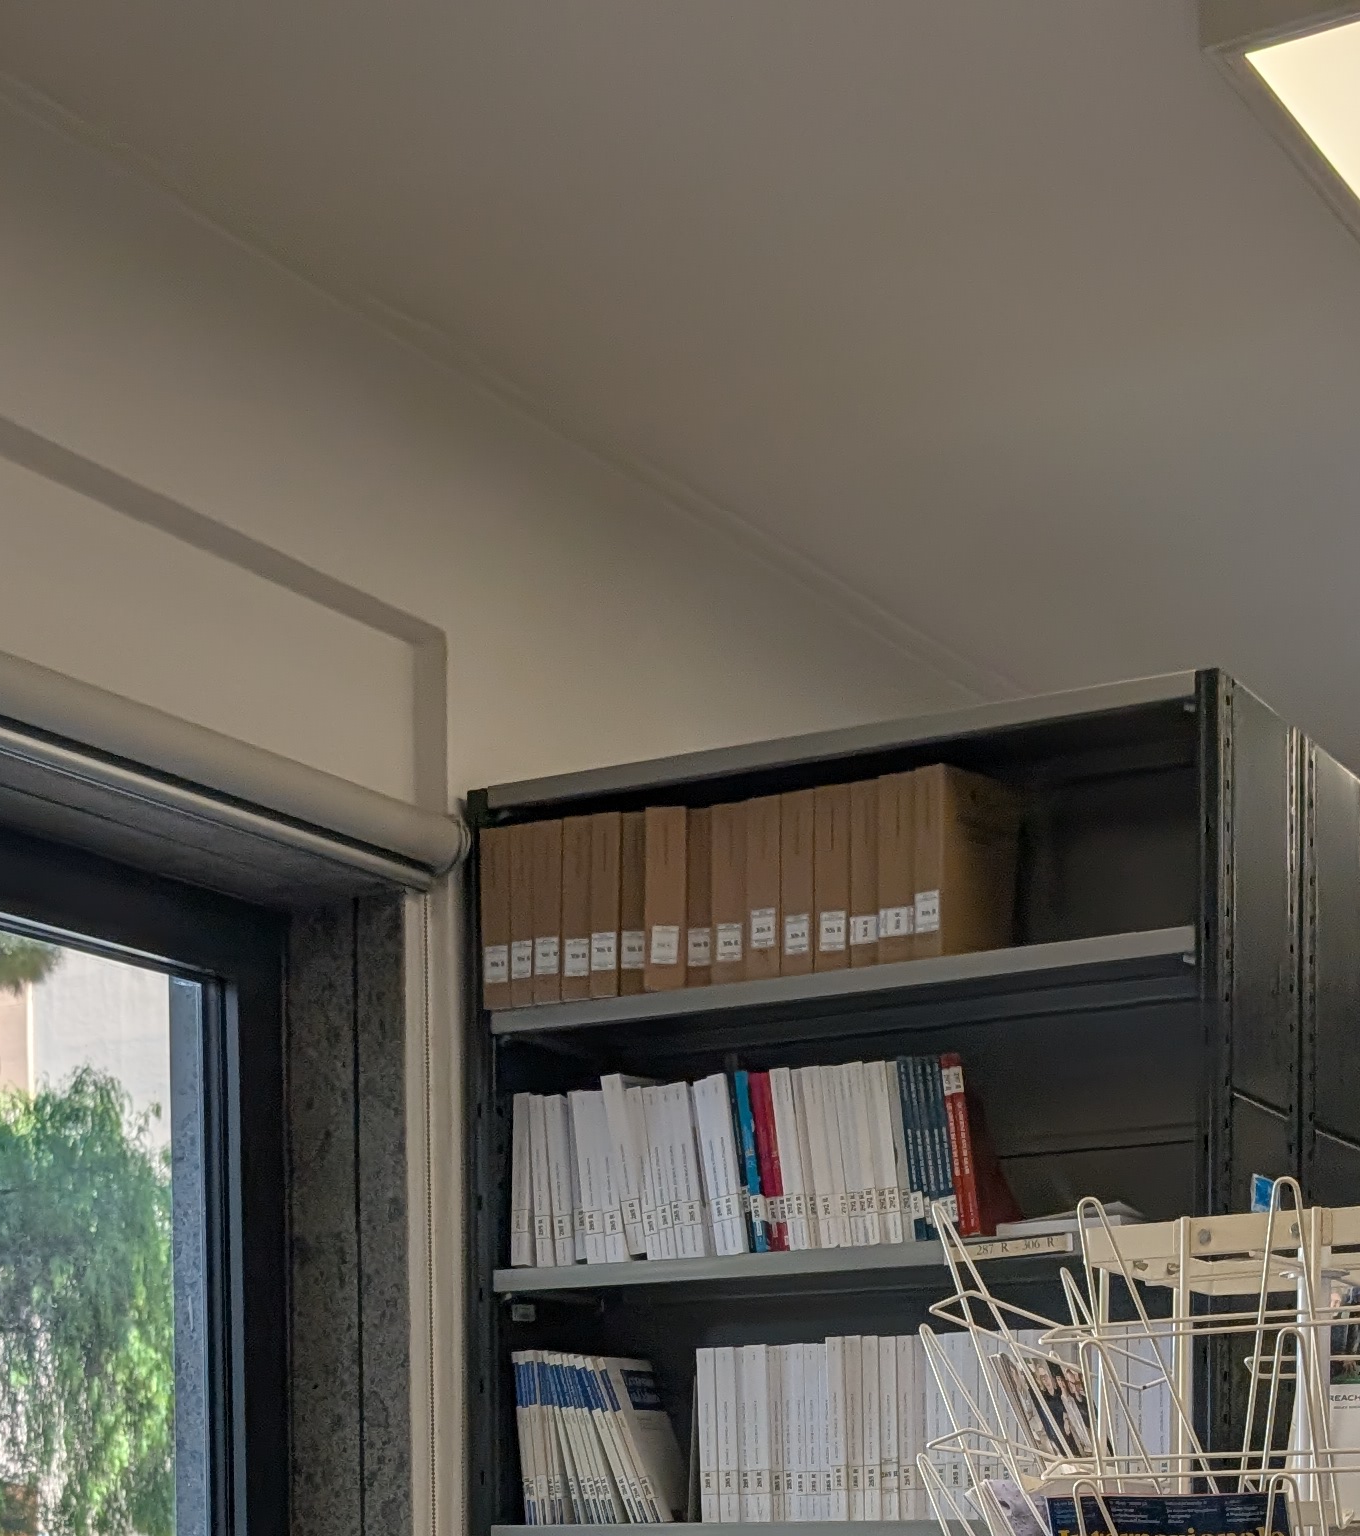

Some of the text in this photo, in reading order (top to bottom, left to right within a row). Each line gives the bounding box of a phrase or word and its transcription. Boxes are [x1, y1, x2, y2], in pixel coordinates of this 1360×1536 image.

[977, 1244, 993, 1255] 287
[1001, 1242, 1009, 1253] R
[1022, 1239, 1040, 1250] 306
[1047, 1237, 1055, 1247] R
